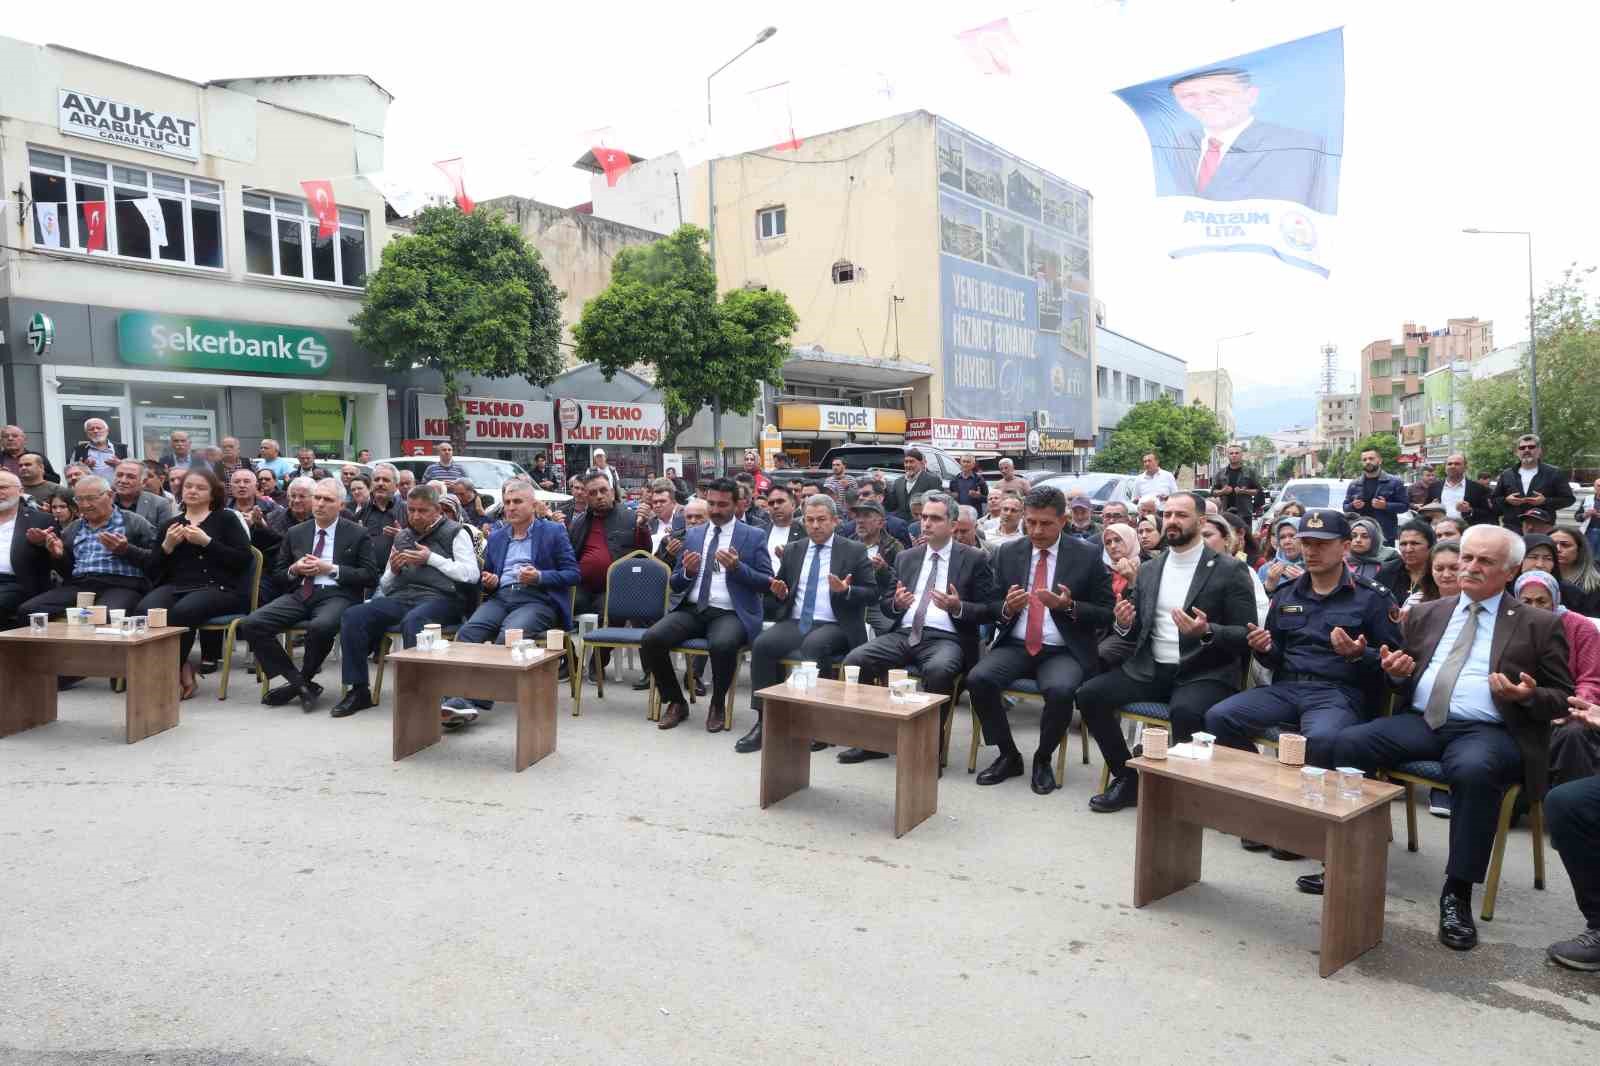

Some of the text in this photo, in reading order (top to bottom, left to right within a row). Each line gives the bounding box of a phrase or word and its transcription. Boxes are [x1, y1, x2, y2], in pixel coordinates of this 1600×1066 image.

[62, 92, 196, 136] AVUKAT
[69, 111, 190, 147] ARABULUCU
[99, 131, 165, 150] CANAN TEK
[151, 325, 293, 359] Şekerbank
[457, 400, 525, 417] EKNO
[587, 405, 642, 421] TEKNO
[475, 418, 550, 439] DÜNYASI
[567, 424, 662, 442] KILIF DÜNYASI
[934, 421, 999, 441] KILIF DÜNYASI
